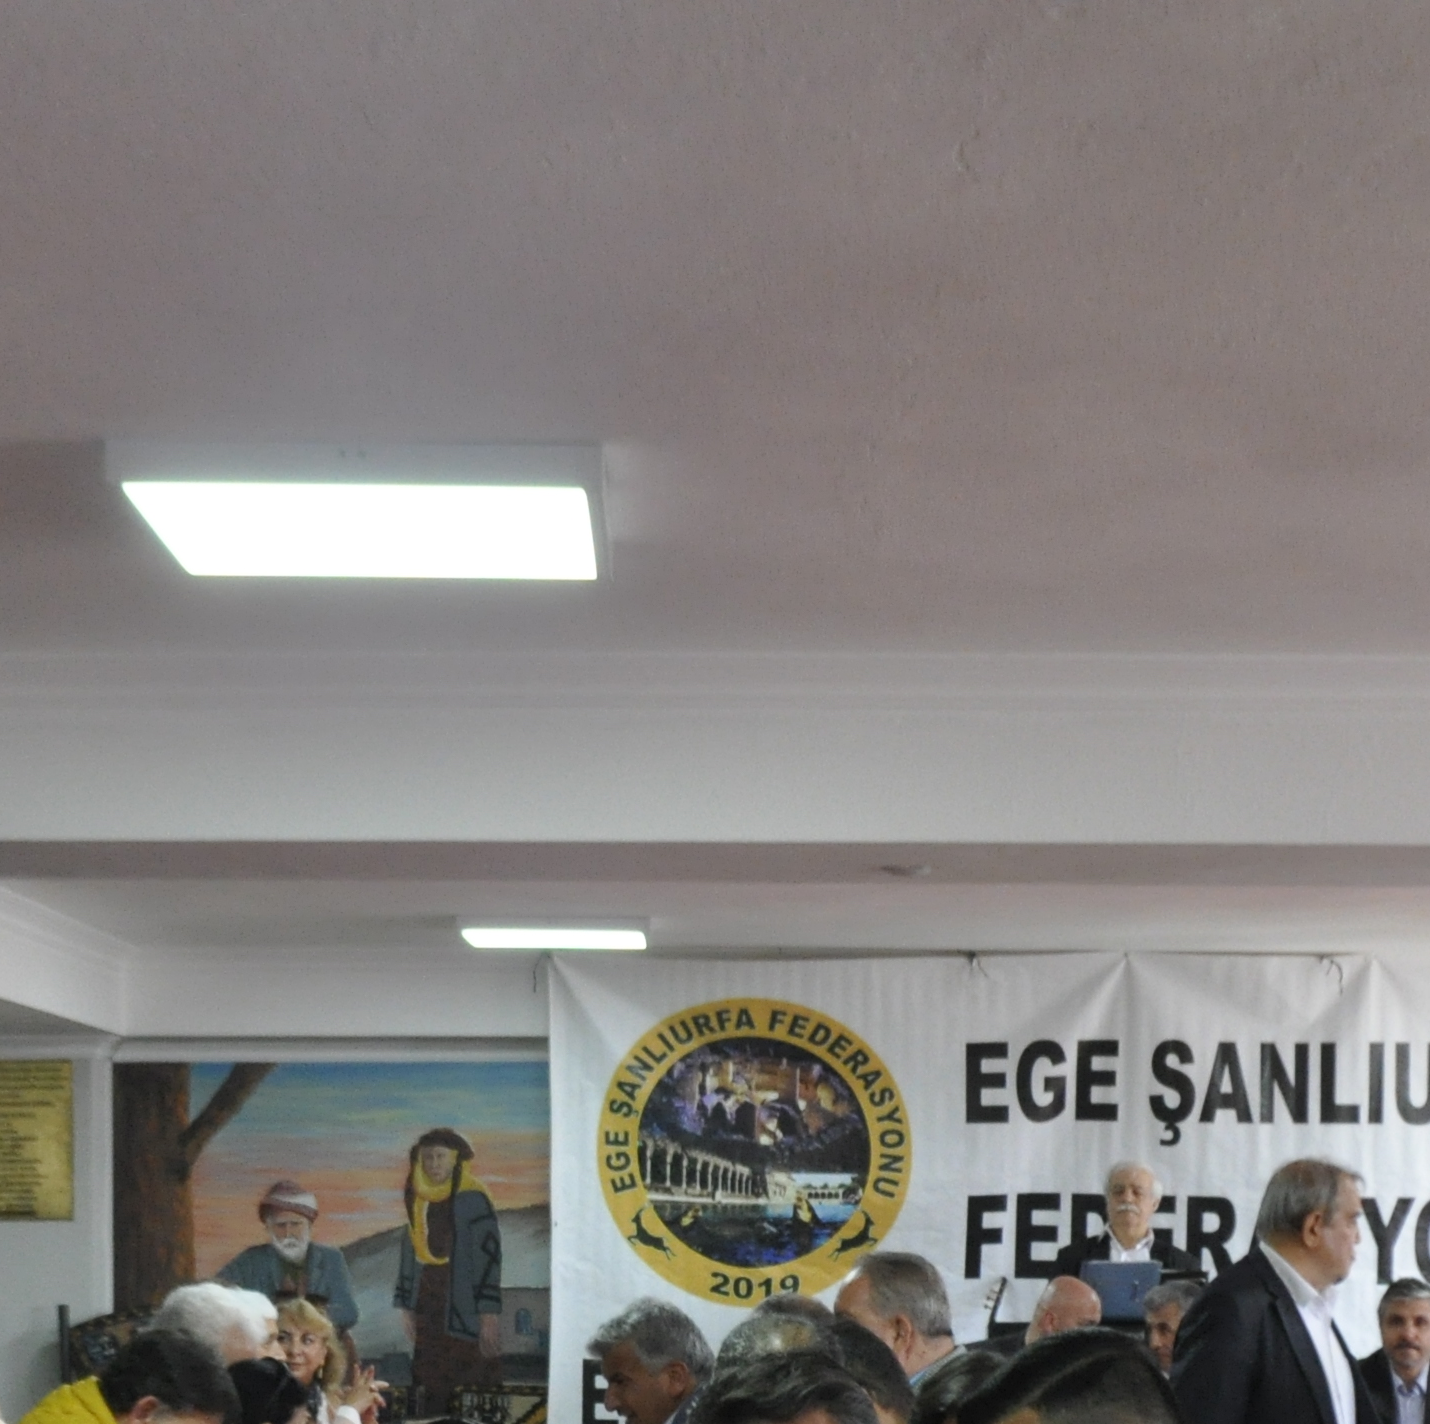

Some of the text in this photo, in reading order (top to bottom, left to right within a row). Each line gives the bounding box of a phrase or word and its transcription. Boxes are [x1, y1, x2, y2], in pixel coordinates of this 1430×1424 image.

[602, 1007, 906, 1200] EGE ŞANLIURFA FEDERASYONU
[964, 1040, 1118, 1124] EGE
[709, 1271, 800, 1299] 2019
